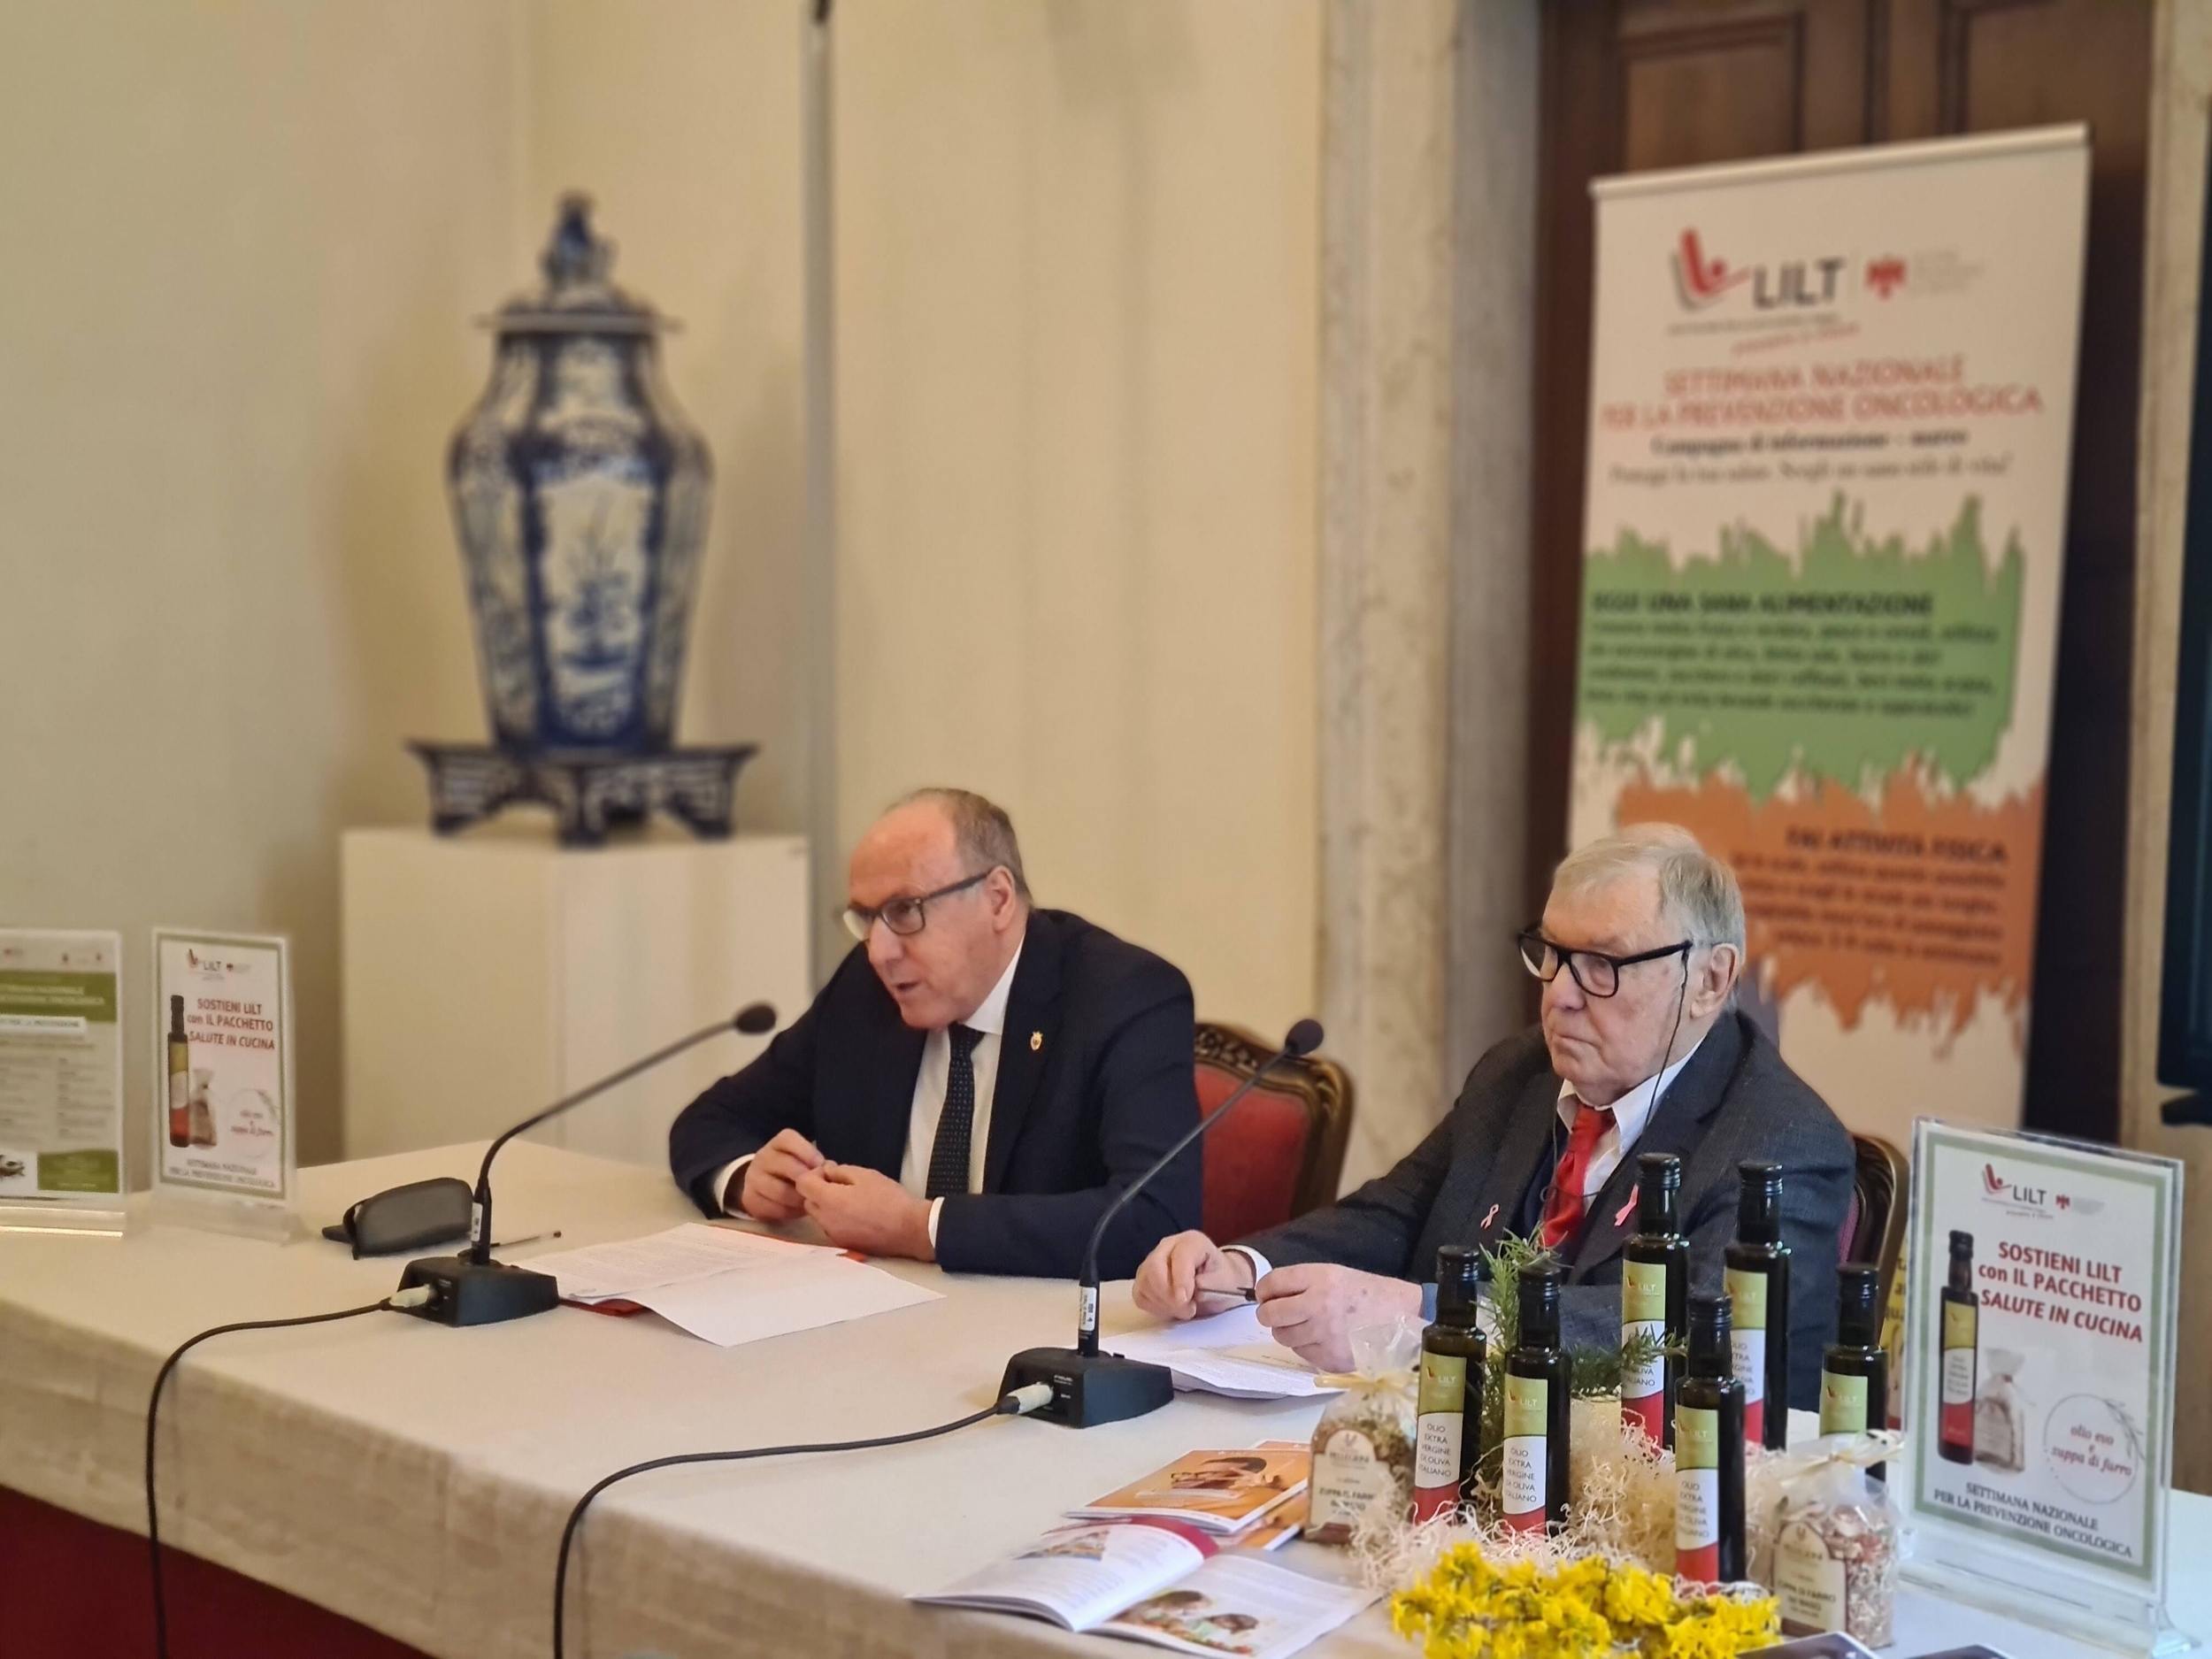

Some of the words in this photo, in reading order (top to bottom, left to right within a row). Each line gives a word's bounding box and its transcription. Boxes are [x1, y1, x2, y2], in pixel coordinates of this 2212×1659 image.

[1753, 257, 1845, 310] LILT
[1663, 366, 1804, 396] SETTIMANA
[1810, 354, 1963, 389] NAZIONALE
[1853, 385, 2044, 422] ONCOLOGICA
[197, 998, 241, 1013] SOSTIENI
[243, 1003, 262, 1016] LILT
[187, 1014, 204, 1025] con
[206, 1014, 214, 1025] IL
[217, 1015, 273, 1032] PACCHETTO
[188, 1031, 224, 1045] SALUTE
[226, 1034, 236, 1047] IN
[239, 1036, 274, 1050] CUCINA
[2013, 1185, 2047, 1205] LILT
[1998, 1241, 2081, 1275] SOSTIENI
[2086, 1260, 2122, 1284] LILT
[1978, 1264, 2008, 1282] con
[2013, 1268, 2028, 1287] IL
[2033, 1272, 2142, 1313] PACCHETTO
[1980, 1289, 2046, 1319] SALUTE
[2048, 1305, 2070, 1325] IN
[2074, 1311, 2143, 1342] CUCINA
[1438, 1375, 1456, 1384] LILT
[1519, 1398, 1538, 1407] LILT
[1427, 1423, 1446, 1433] OLIO
[2070, 1424, 2092, 1440] olio
[2094, 1432, 2114, 1446] evo
[1425, 1432, 1448, 1445] EXTRA
[1421, 1443, 1451, 1455] VERGINE
[1510, 1447, 1529, 1457] OLIO
[2051, 1445, 2085, 1465] zuppa
[2088, 1453, 2101, 1468] di
[2088, 1444, 2095, 1454] e
[1428, 1455, 1451, 1466] OLIVA
[1508, 1456, 1532, 1469] EXTRA
[1418, 1464, 1452, 1478] ITALIANO
[1506, 1468, 1535, 1480] VERGINE
[1514, 1479, 1536, 1492] OLIVA
[1966, 1482, 2029, 1511] SETTIMANA
[2032, 1502, 2099, 1531] NAZIONALE
[1934, 1488, 1955, 1506] PER
[1957, 1495, 1971, 1510] LA
[1973, 1502, 2051, 1534] PREVENZIONE
[2054, 1524, 2132, 1558] ONCOLOGICA
